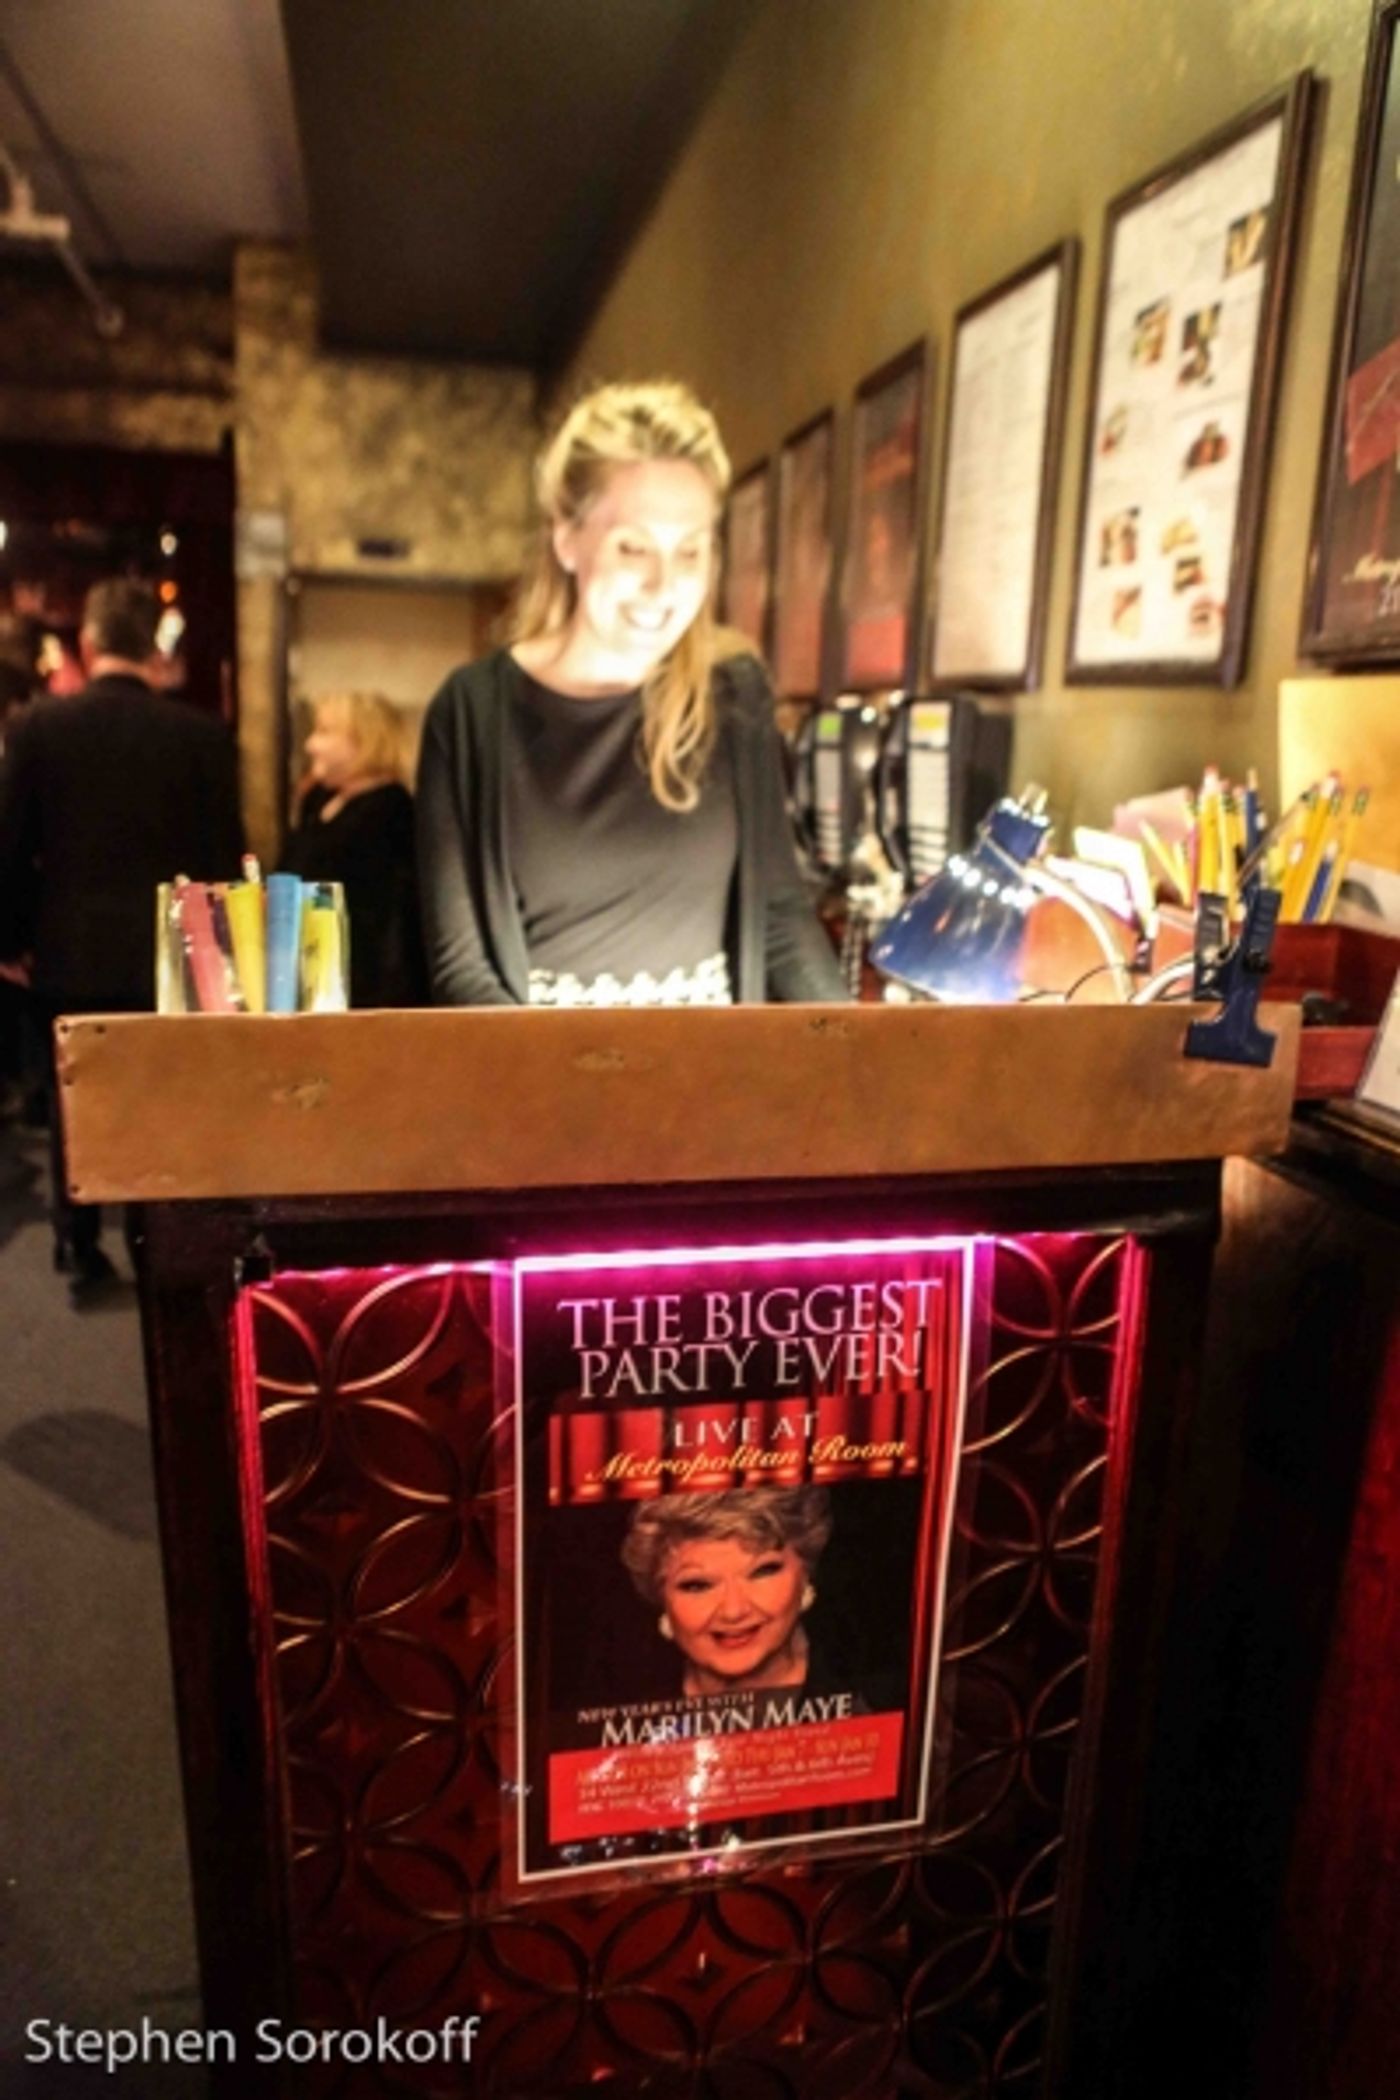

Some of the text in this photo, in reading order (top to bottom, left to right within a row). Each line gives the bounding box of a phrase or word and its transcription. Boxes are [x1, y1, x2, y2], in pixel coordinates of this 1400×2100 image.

[557, 1278, 942, 1350] THE BIGGEST
[578, 1330, 924, 1399] PARTY EVER!
[674, 1410, 820, 1448] LIVE AT
[584, 1435, 907, 1484] Metropolitan Room
[601, 1704, 755, 1749] MARILYN
[762, 1692, 853, 1730] MAYE
